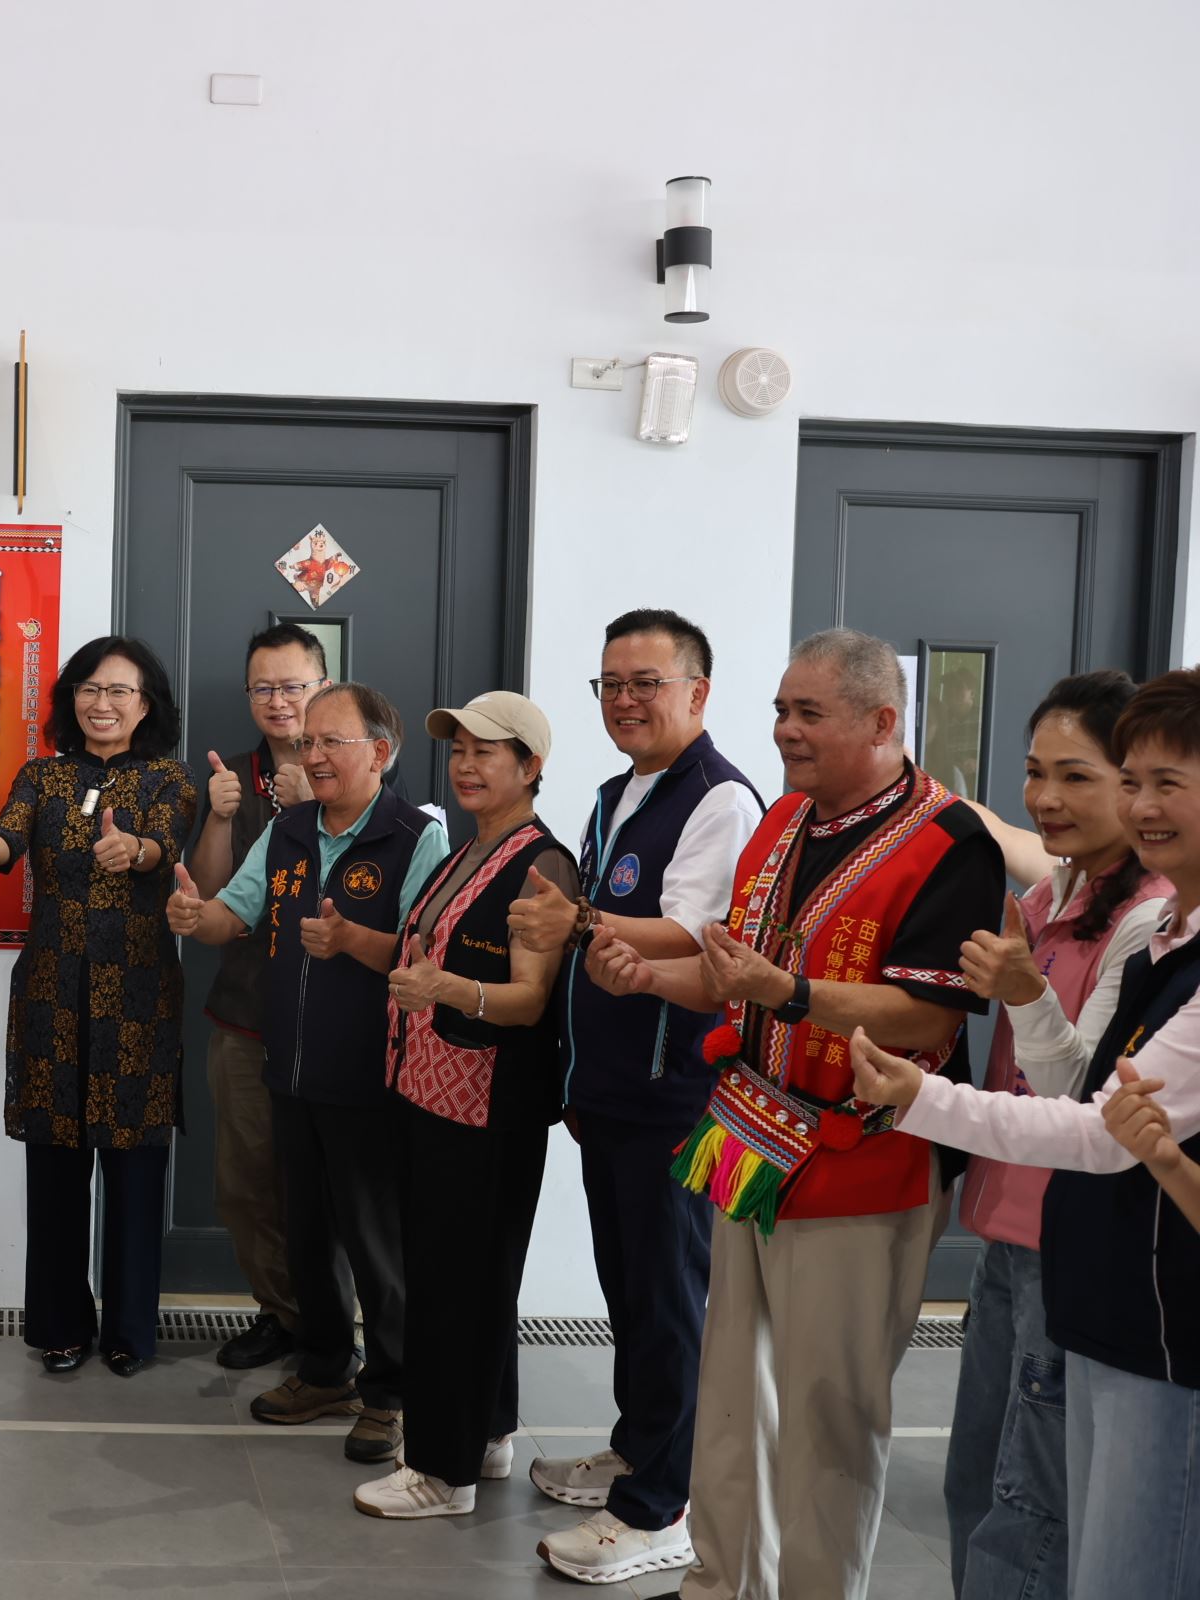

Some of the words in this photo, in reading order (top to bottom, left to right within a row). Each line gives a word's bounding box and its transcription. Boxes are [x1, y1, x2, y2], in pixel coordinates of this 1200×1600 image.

[289, 860, 307, 898] 議員
[806, 915, 857, 1057] 文化傳承協會
[824, 918, 880, 1068] 苗栗縣族
